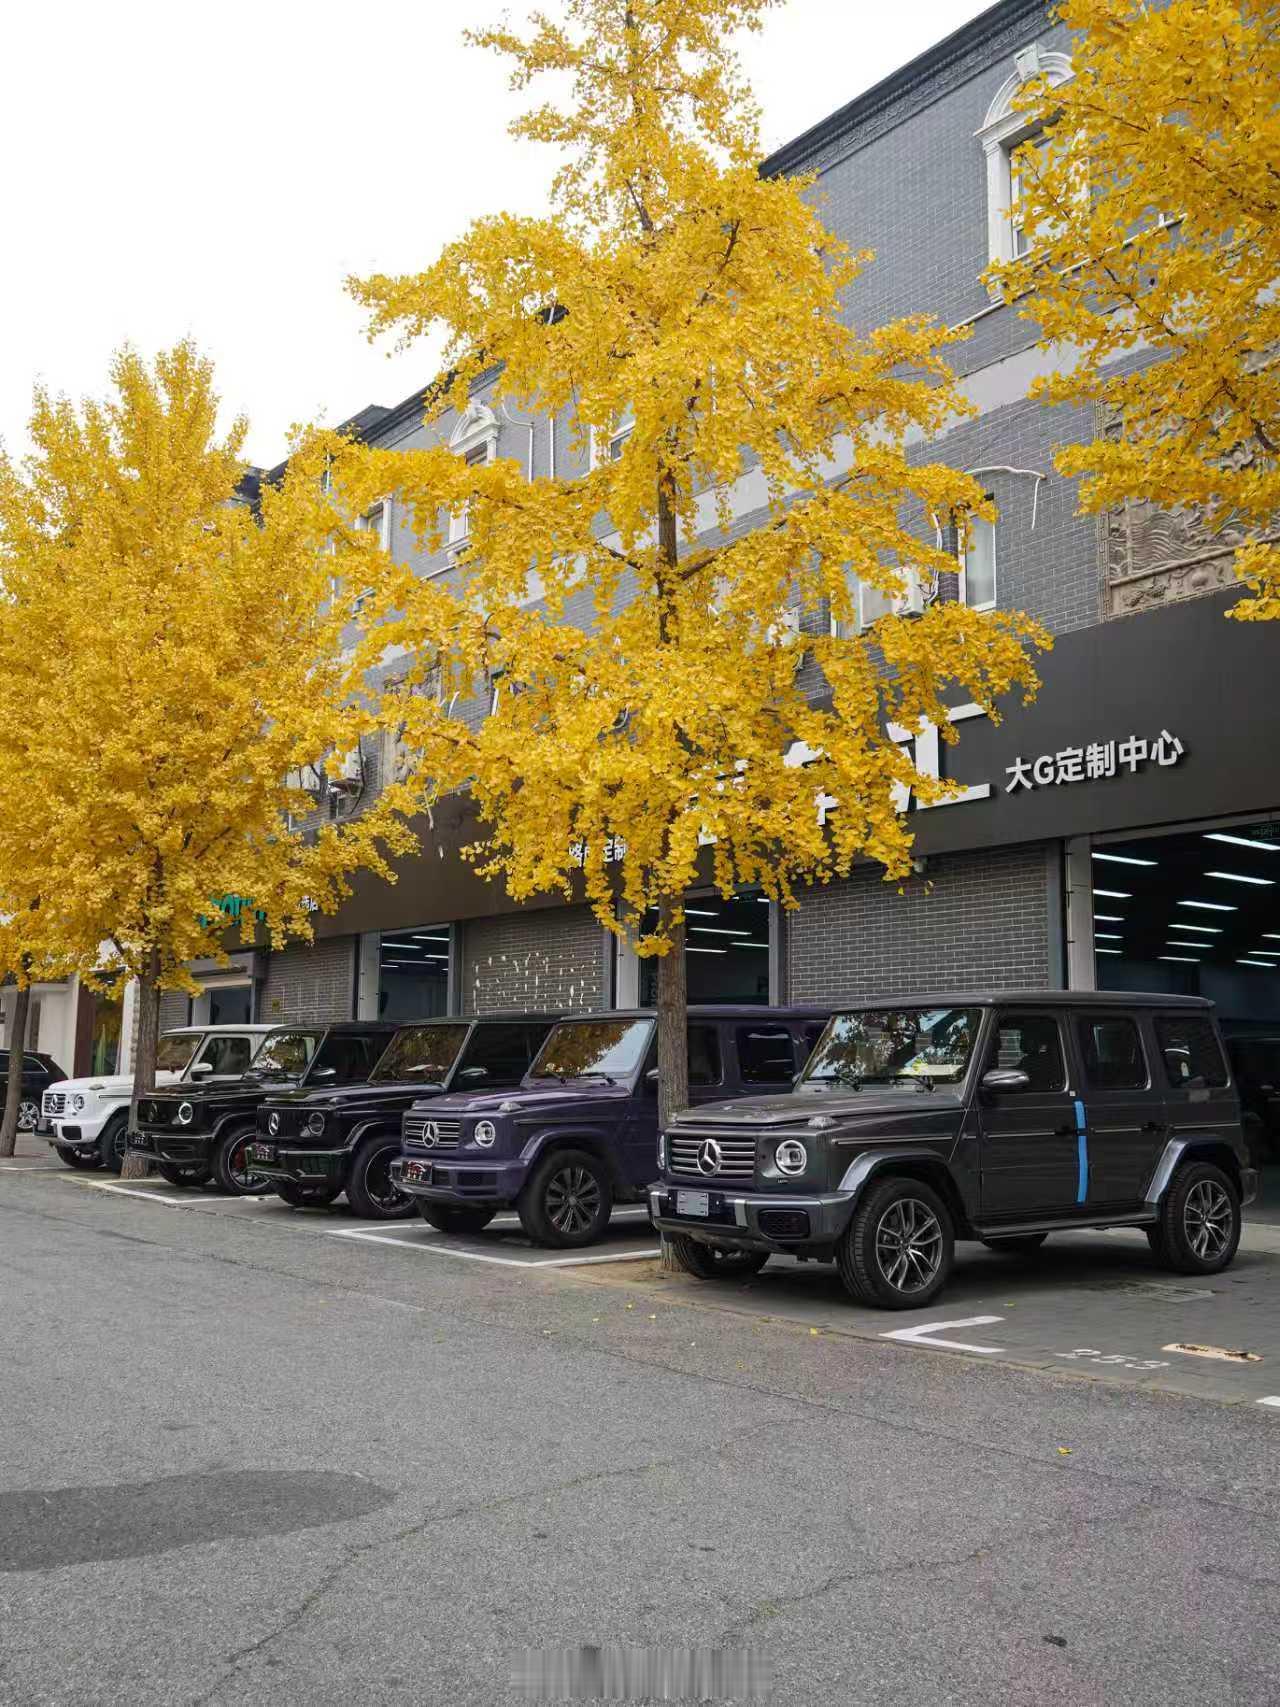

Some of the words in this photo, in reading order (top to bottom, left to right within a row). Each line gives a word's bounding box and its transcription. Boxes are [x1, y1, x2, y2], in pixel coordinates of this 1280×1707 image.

[1005, 729, 1184, 793] 大G定制中心
